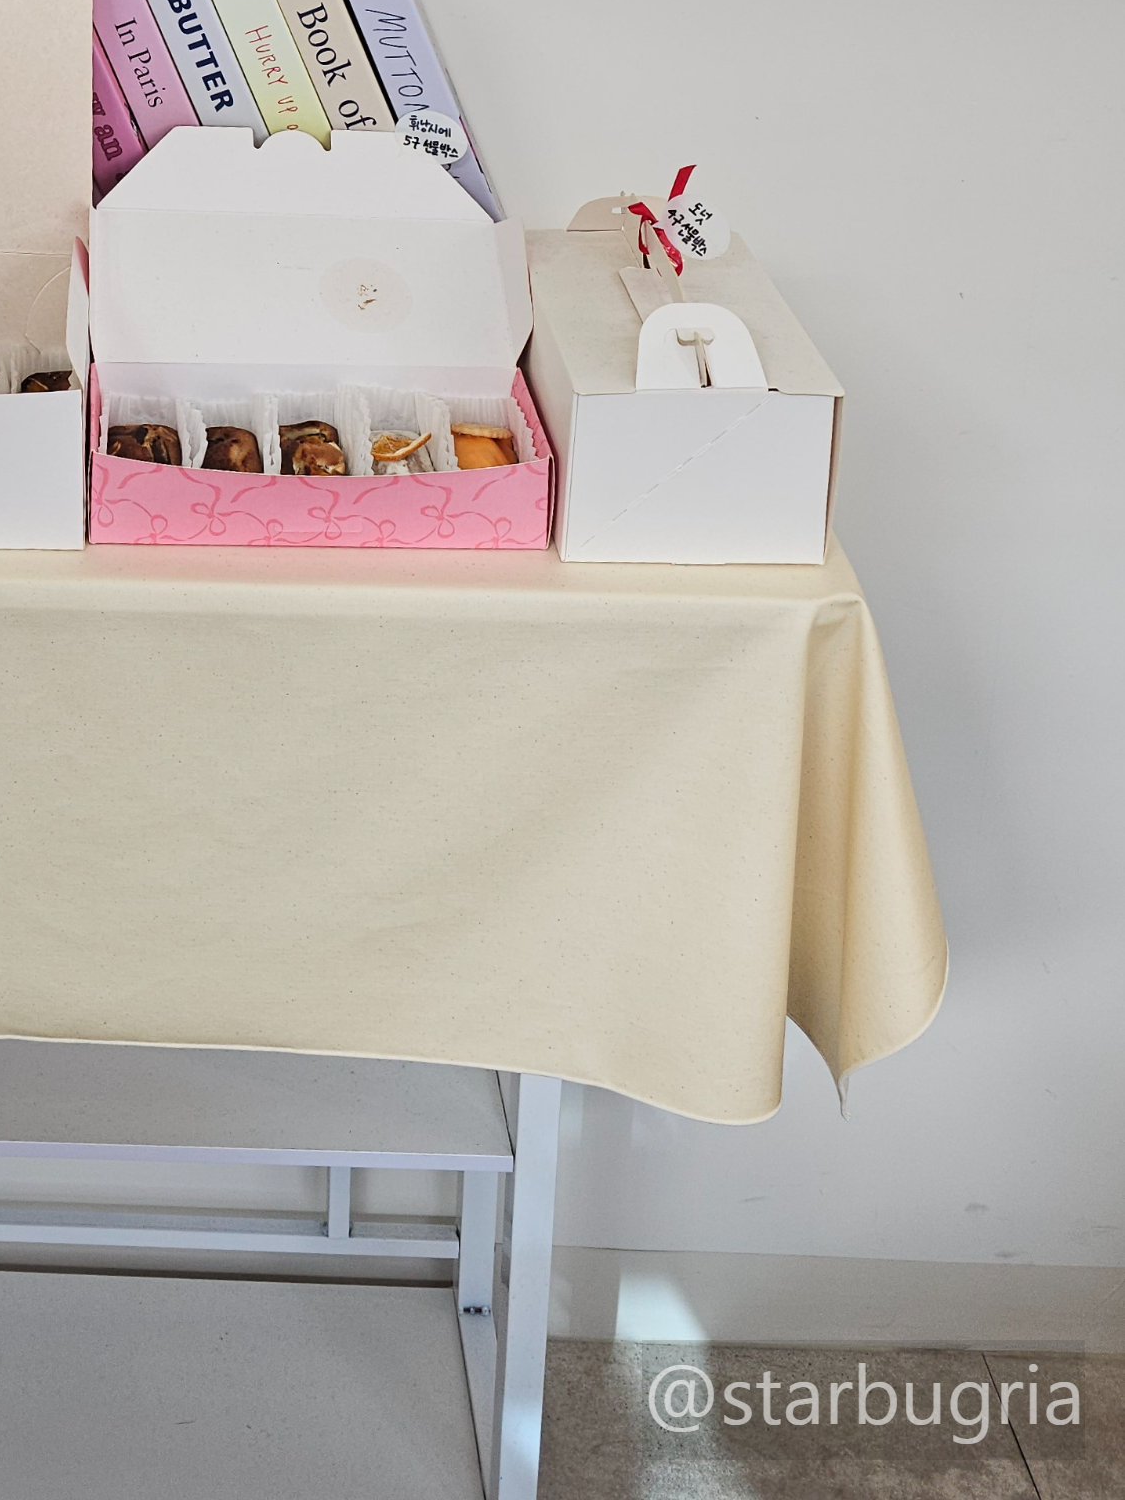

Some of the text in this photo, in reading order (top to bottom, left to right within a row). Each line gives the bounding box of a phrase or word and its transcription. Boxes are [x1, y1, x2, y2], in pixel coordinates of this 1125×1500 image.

[114, 17, 166, 108] In Paris
[245, 25, 288, 85] HURRY
[278, 96, 298, 113] UP
[297, 2, 377, 130] Book of
[403, 135, 459, 158] 5구 선물박스
[409, 115, 452, 138] 휘낭시에
[667, 209, 707, 257] 4구 선물박스
[688, 202, 713, 226] 도넛
